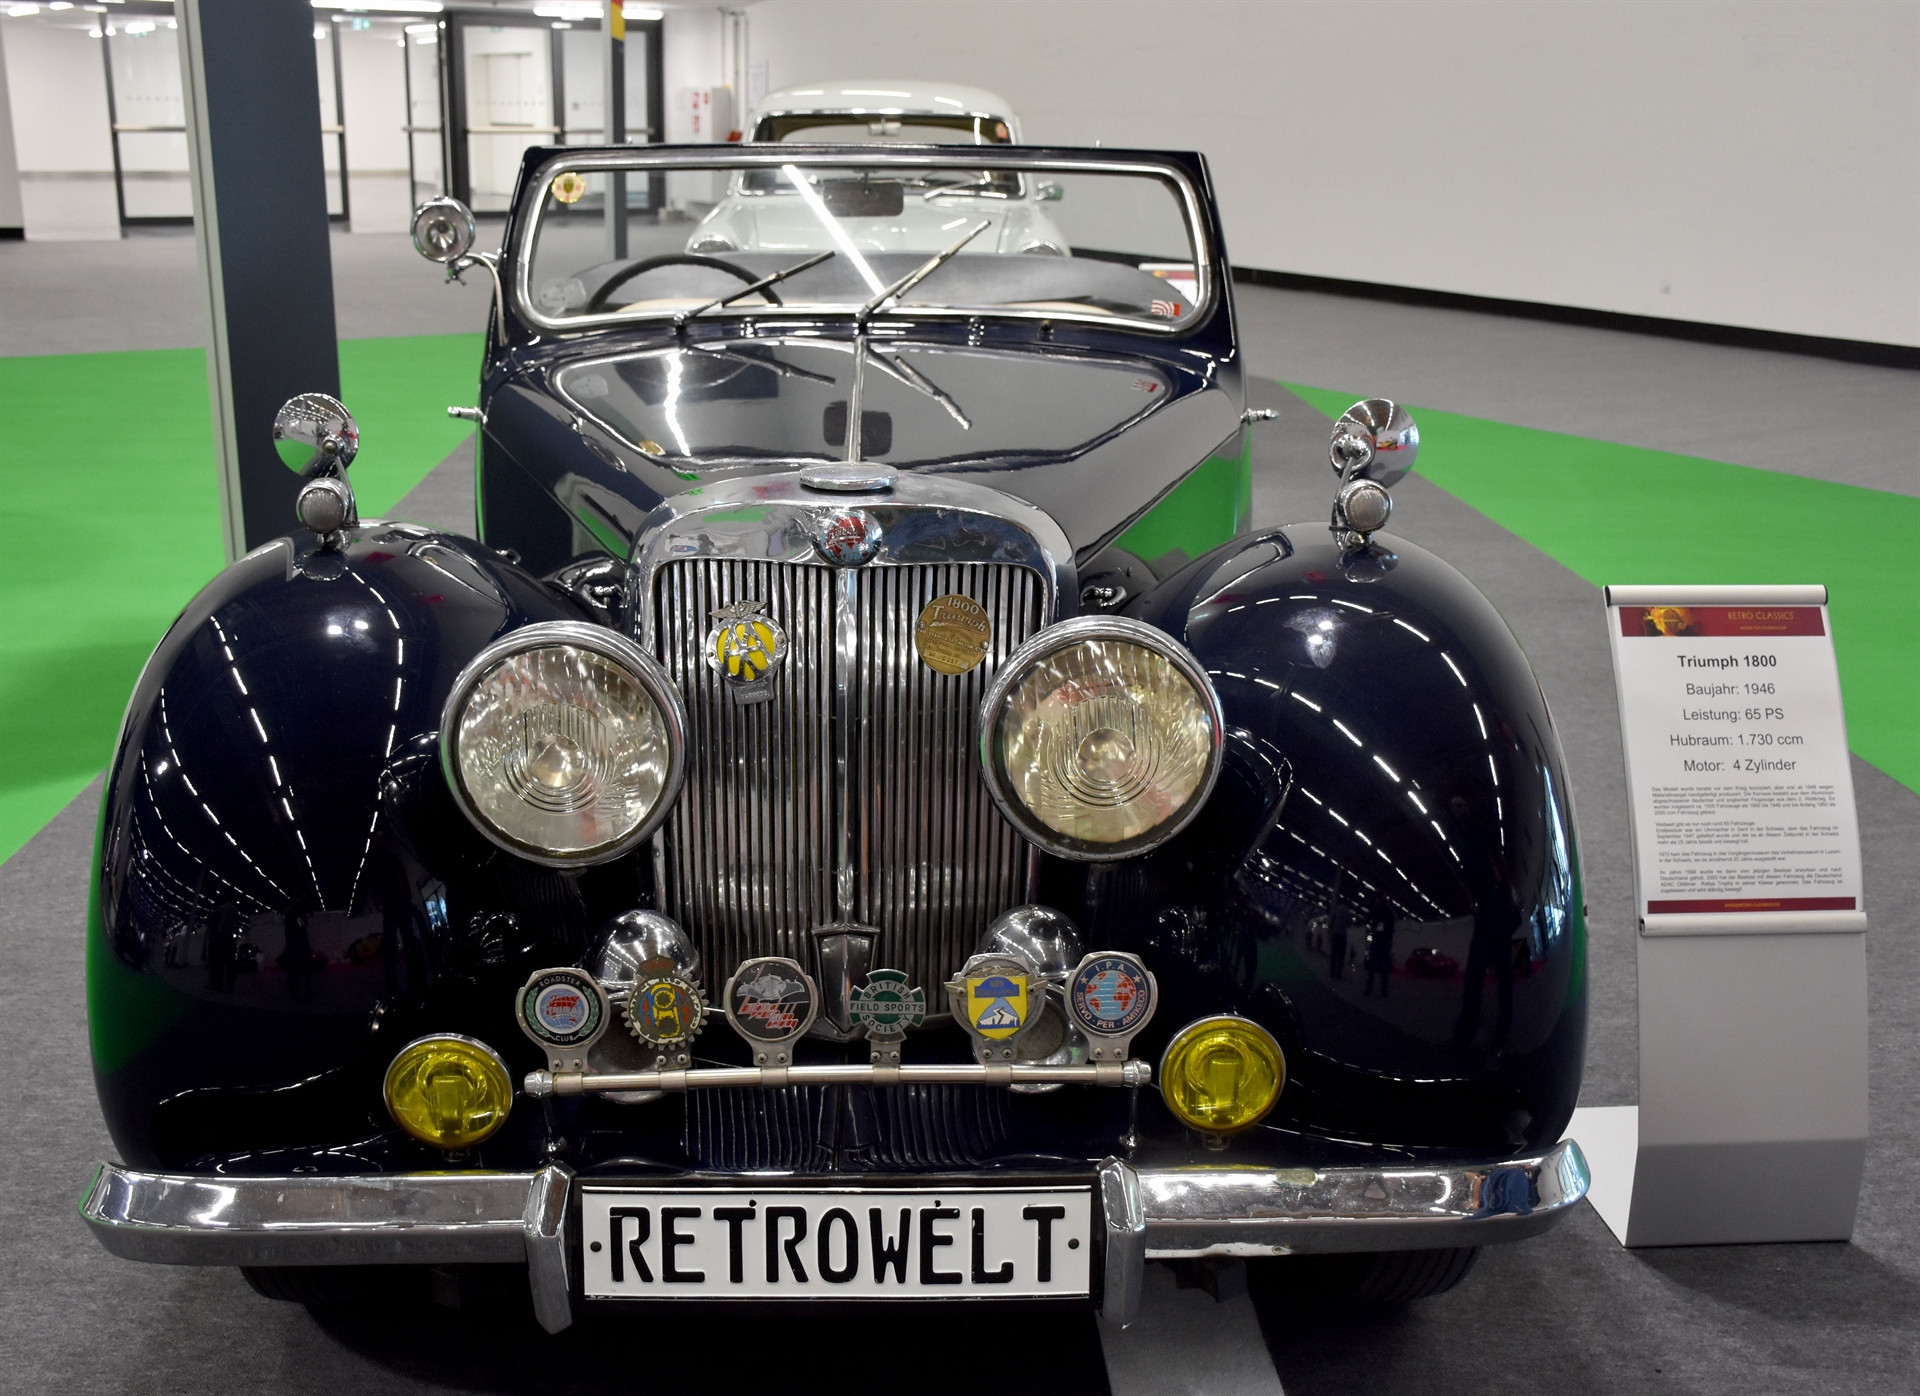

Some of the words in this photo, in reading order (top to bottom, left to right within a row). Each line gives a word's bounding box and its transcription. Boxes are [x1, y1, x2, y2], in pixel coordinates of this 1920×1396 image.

[948, 598, 979, 614] 1800
[1755, 611, 1794, 620] CLASSICS
[1677, 655, 1739, 670] Triumph
[1743, 655, 1777, 667] 1800
[1686, 683, 1740, 698] Baujahr:
[1744, 683, 1776, 694] 1946
[1683, 708, 1741, 723] Leistung:
[1745, 708, 1761, 720] 65
[1765, 708, 1784, 720] PS
[1670, 734, 1733, 746] Hubraum:
[1738, 734, 1773, 745] 1.730
[1777, 736, 1804, 744] ccm
[1684, 760, 1725, 771] Motor:
[1733, 760, 1740, 770] 4
[1745, 759, 1796, 774] Zylinder
[1094, 962, 1126, 972] I.P.A.
[538, 976, 581, 987] ROADSTER
[864, 982, 911, 1000] BRITISH
[850, 1002, 880, 1011] FIELD
[884, 1003, 924, 1012] SPORTS
[1076, 992, 1092, 1020] SERVO
[1097, 1020, 1114, 1028] PER
[1122, 990, 1146, 1026] AMIKECO
[862, 1014, 909, 1032] SOCIETY
[609, 1205, 1066, 1285] RETROWELT
